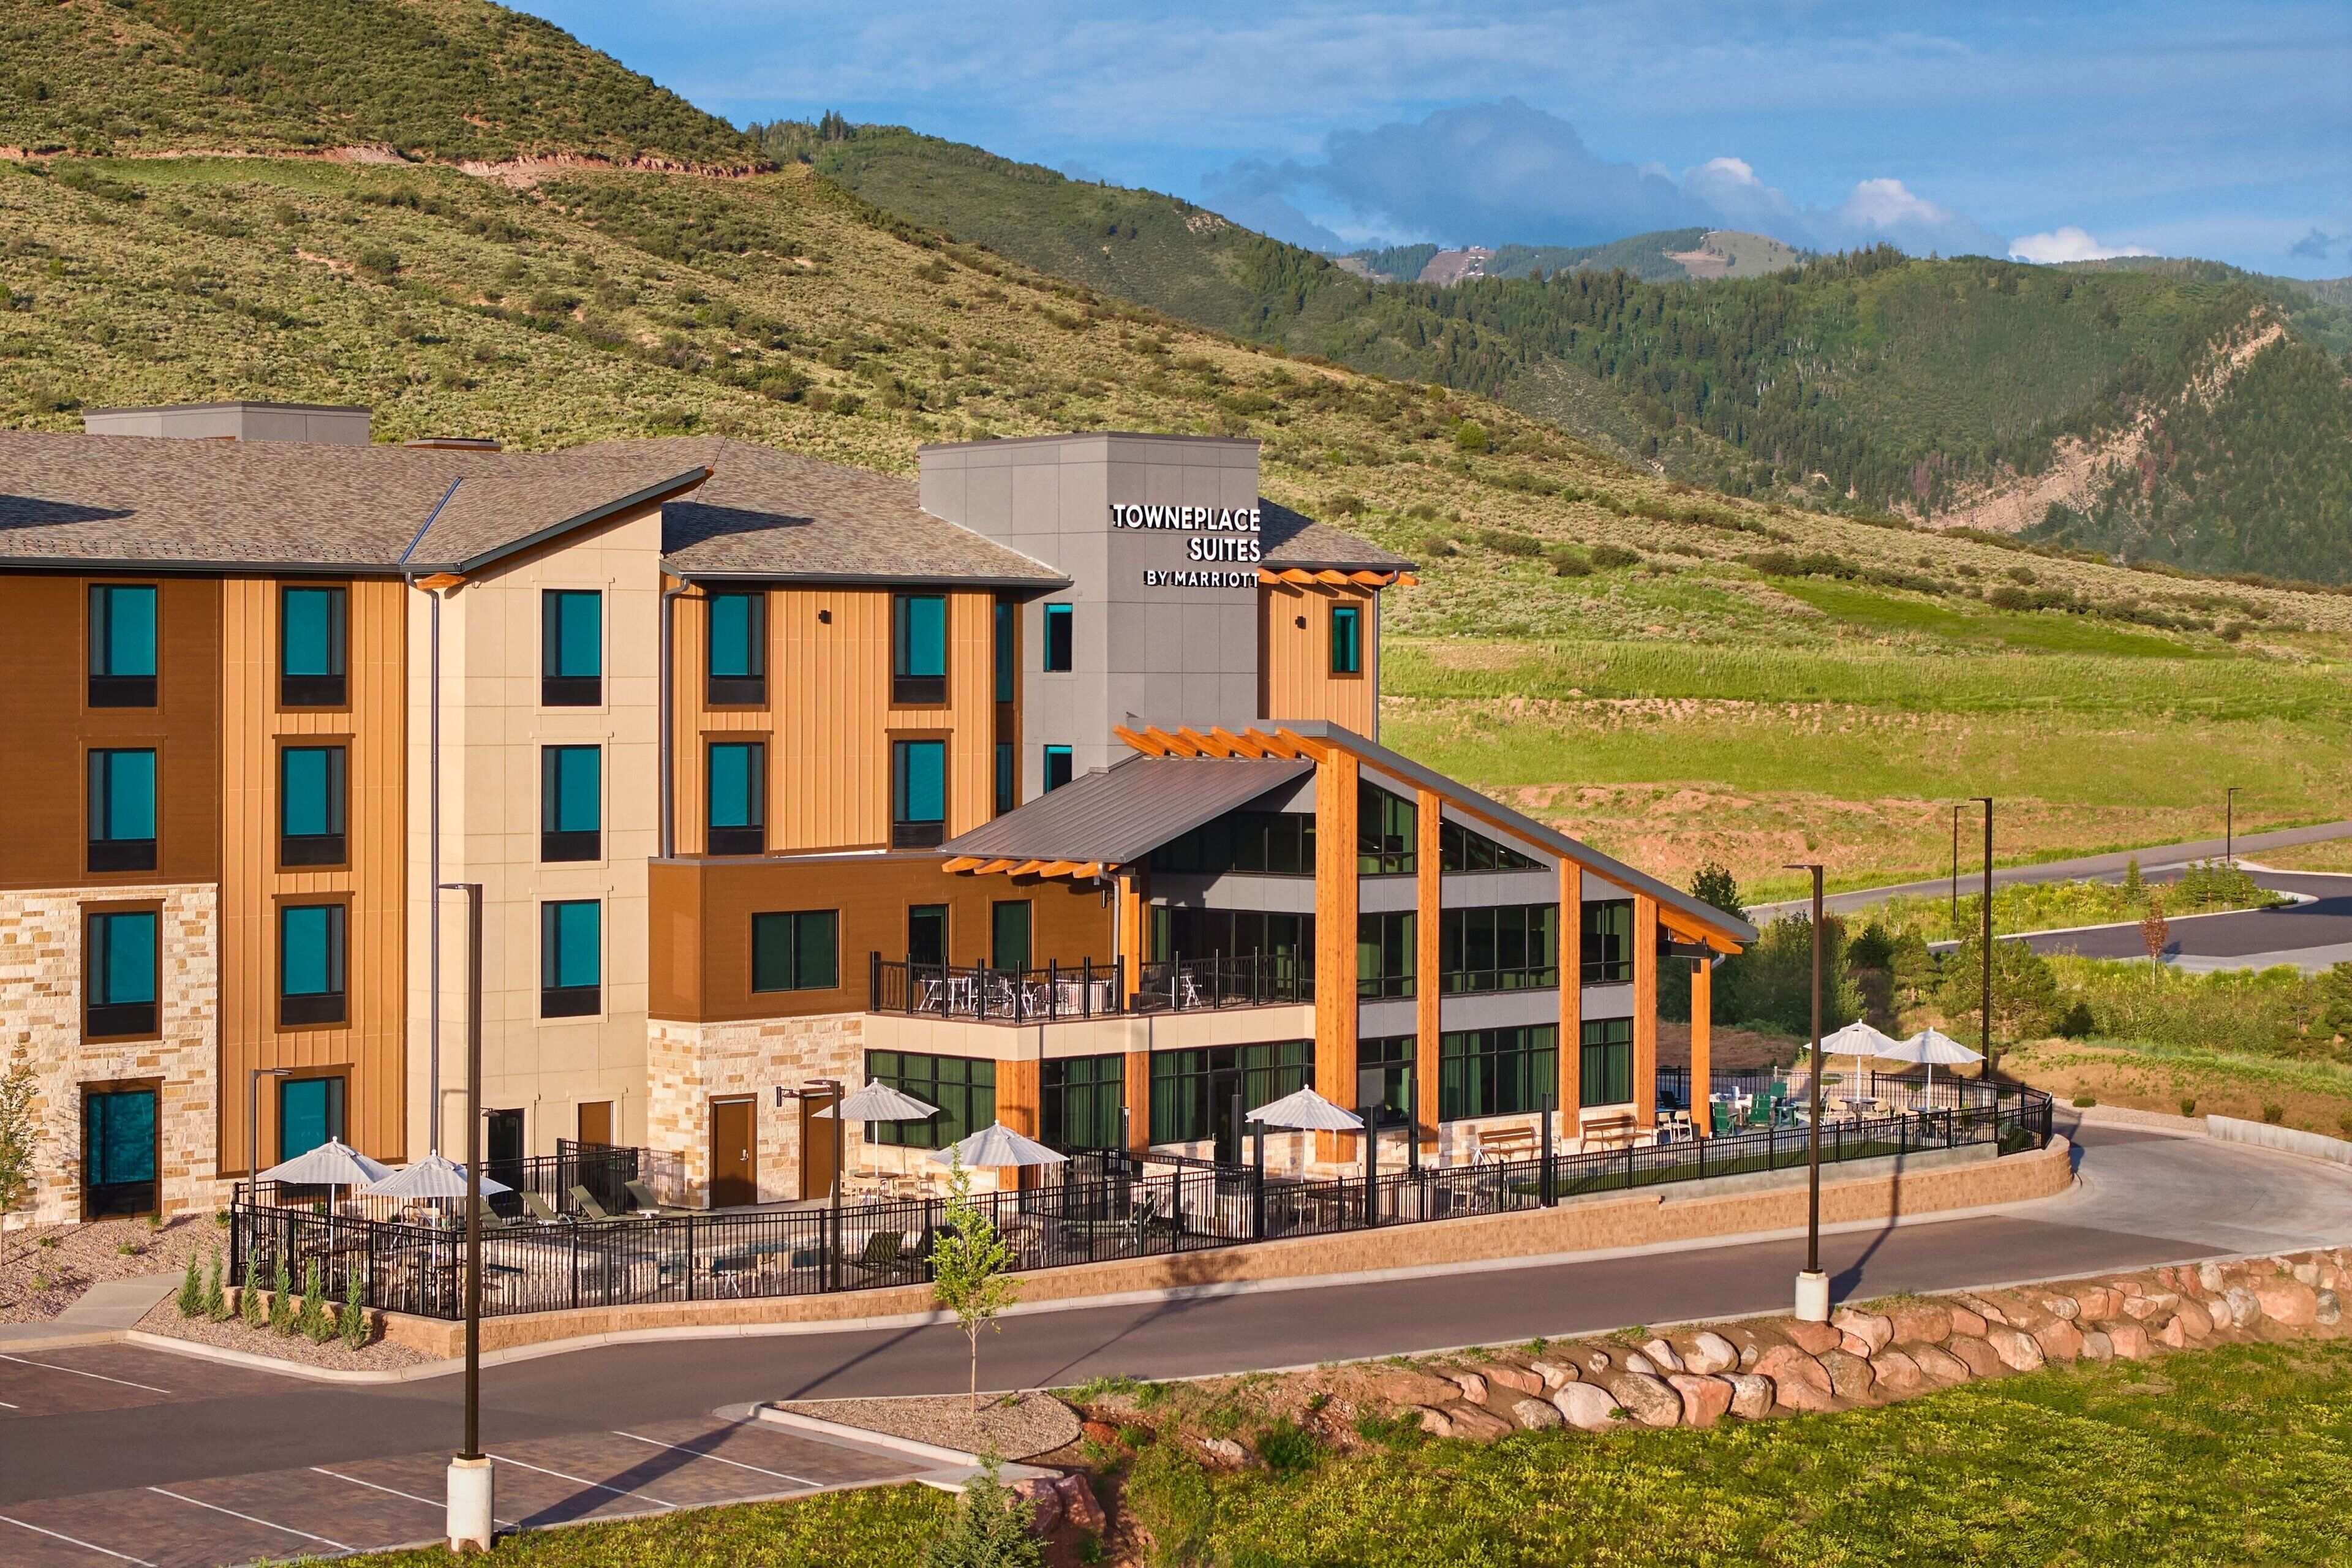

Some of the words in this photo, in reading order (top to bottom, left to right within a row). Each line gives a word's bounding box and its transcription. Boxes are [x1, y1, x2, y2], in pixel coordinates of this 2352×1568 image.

[1113, 504, 1261, 532] TOWNEPLACE
[1189, 537, 1261, 562] SUITES
[1147, 570, 1167, 586] BY
[1175, 571, 1261, 587] MARRIOTT
